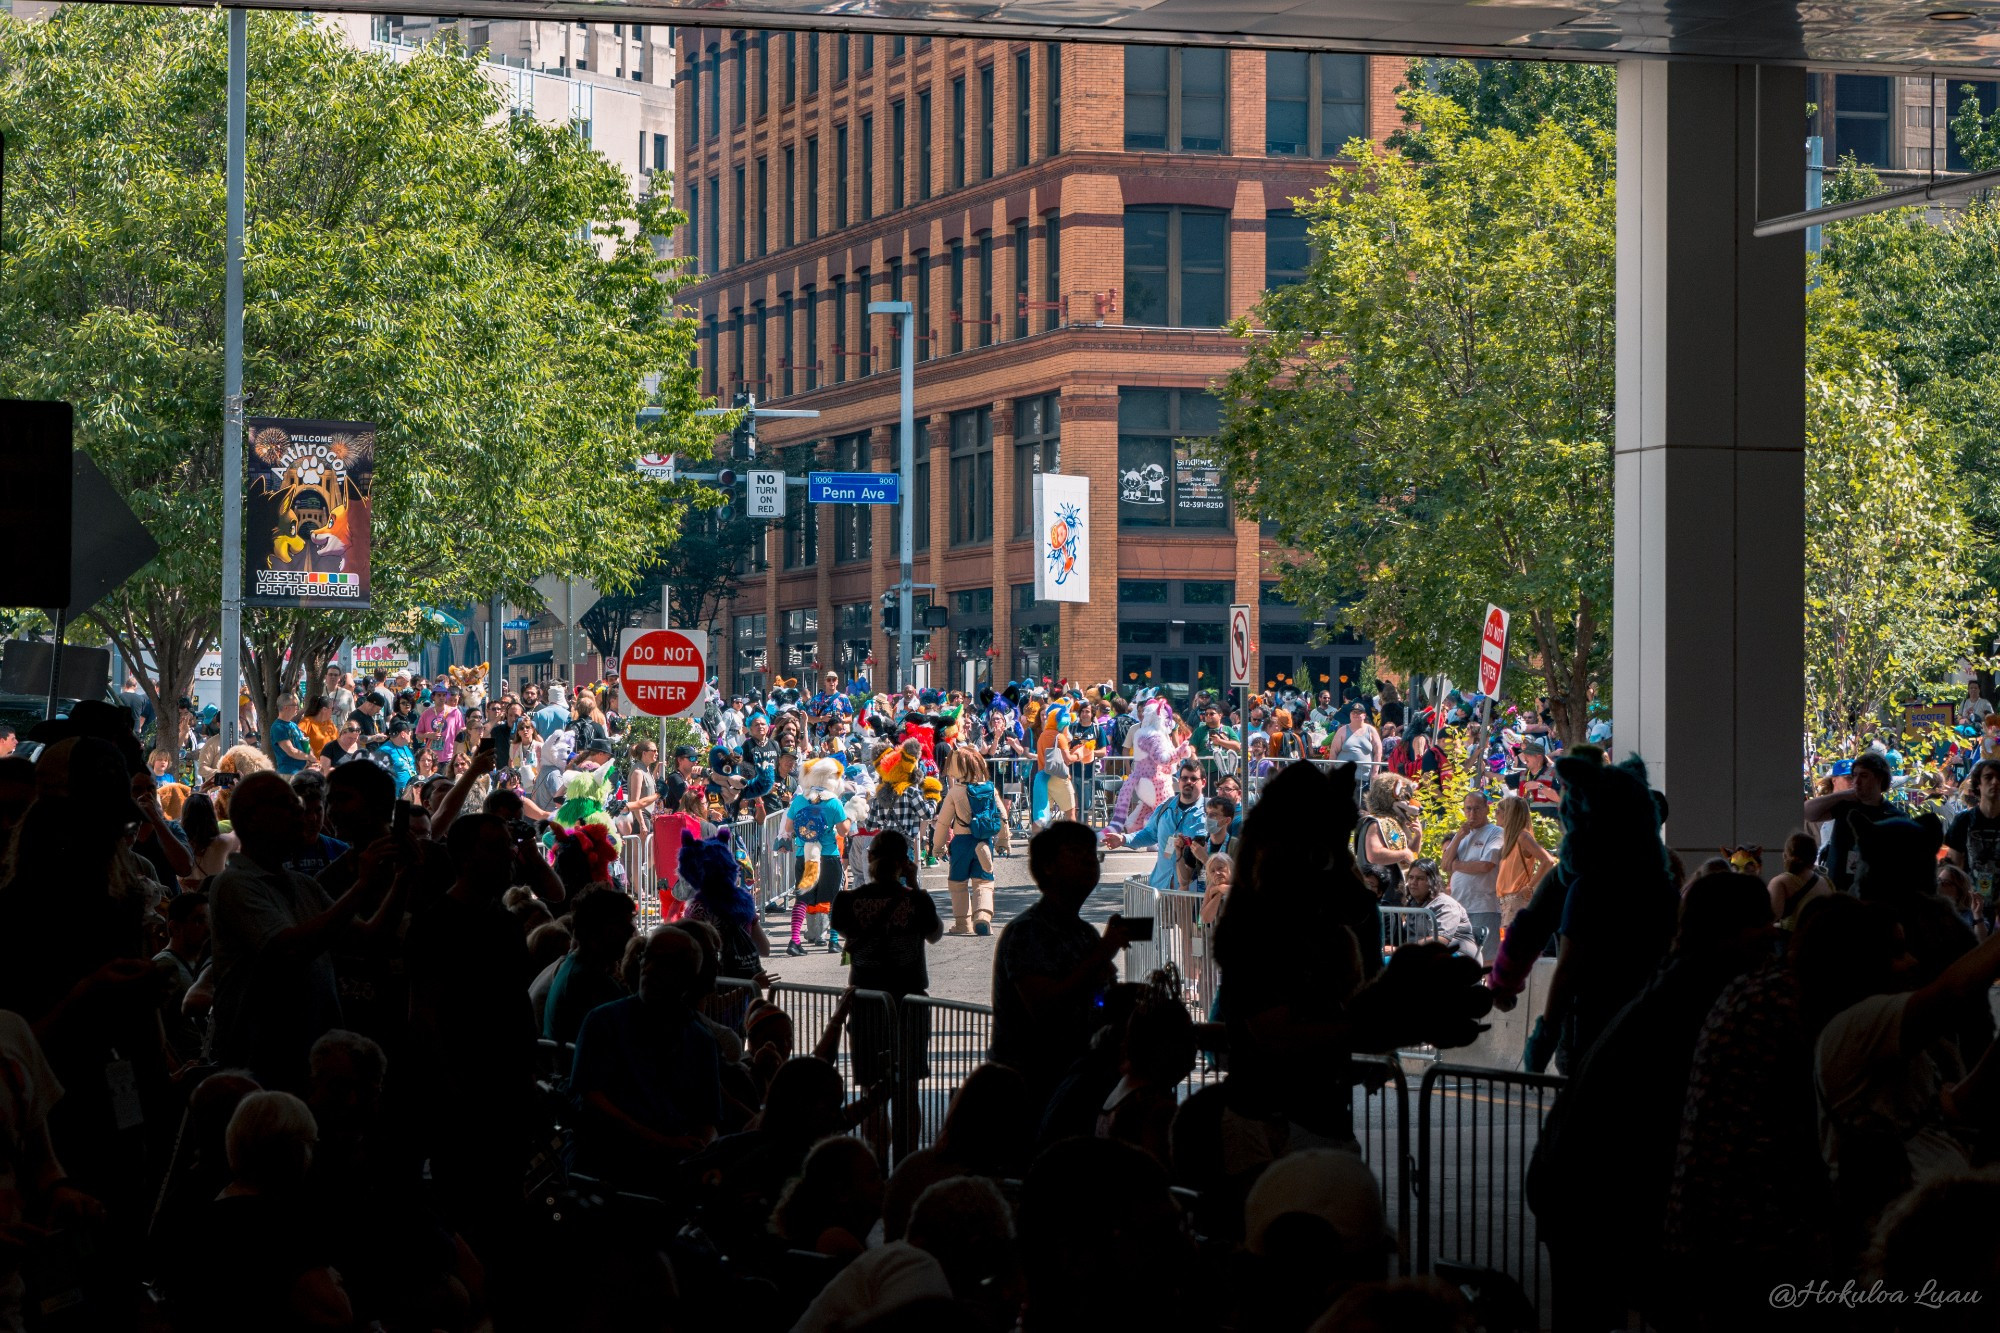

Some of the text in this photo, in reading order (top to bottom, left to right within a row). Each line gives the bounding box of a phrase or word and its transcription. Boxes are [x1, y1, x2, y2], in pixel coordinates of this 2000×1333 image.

[291, 434, 333, 443] WELCOME
[271, 442, 347, 482] Anthrocon
[639, 468, 671, 478] XCEPT
[756, 474, 775, 485] NO
[815, 476, 894, 485] 1000 900
[755, 486, 778, 495] TURN
[822, 486, 886, 499] Penn Ave
[760, 496, 773, 504] ON
[757, 505, 775, 513] RED
[256, 569, 308, 584] VISIT
[256, 582, 360, 598] PITTSBURGH
[1486, 622, 1503, 643] DO NOT
[633, 646, 694, 661] DO NOT
[1483, 662, 1496, 681] ENTER
[637, 685, 687, 700] ENTER
[1911, 713, 1945, 721] SCOOTER
